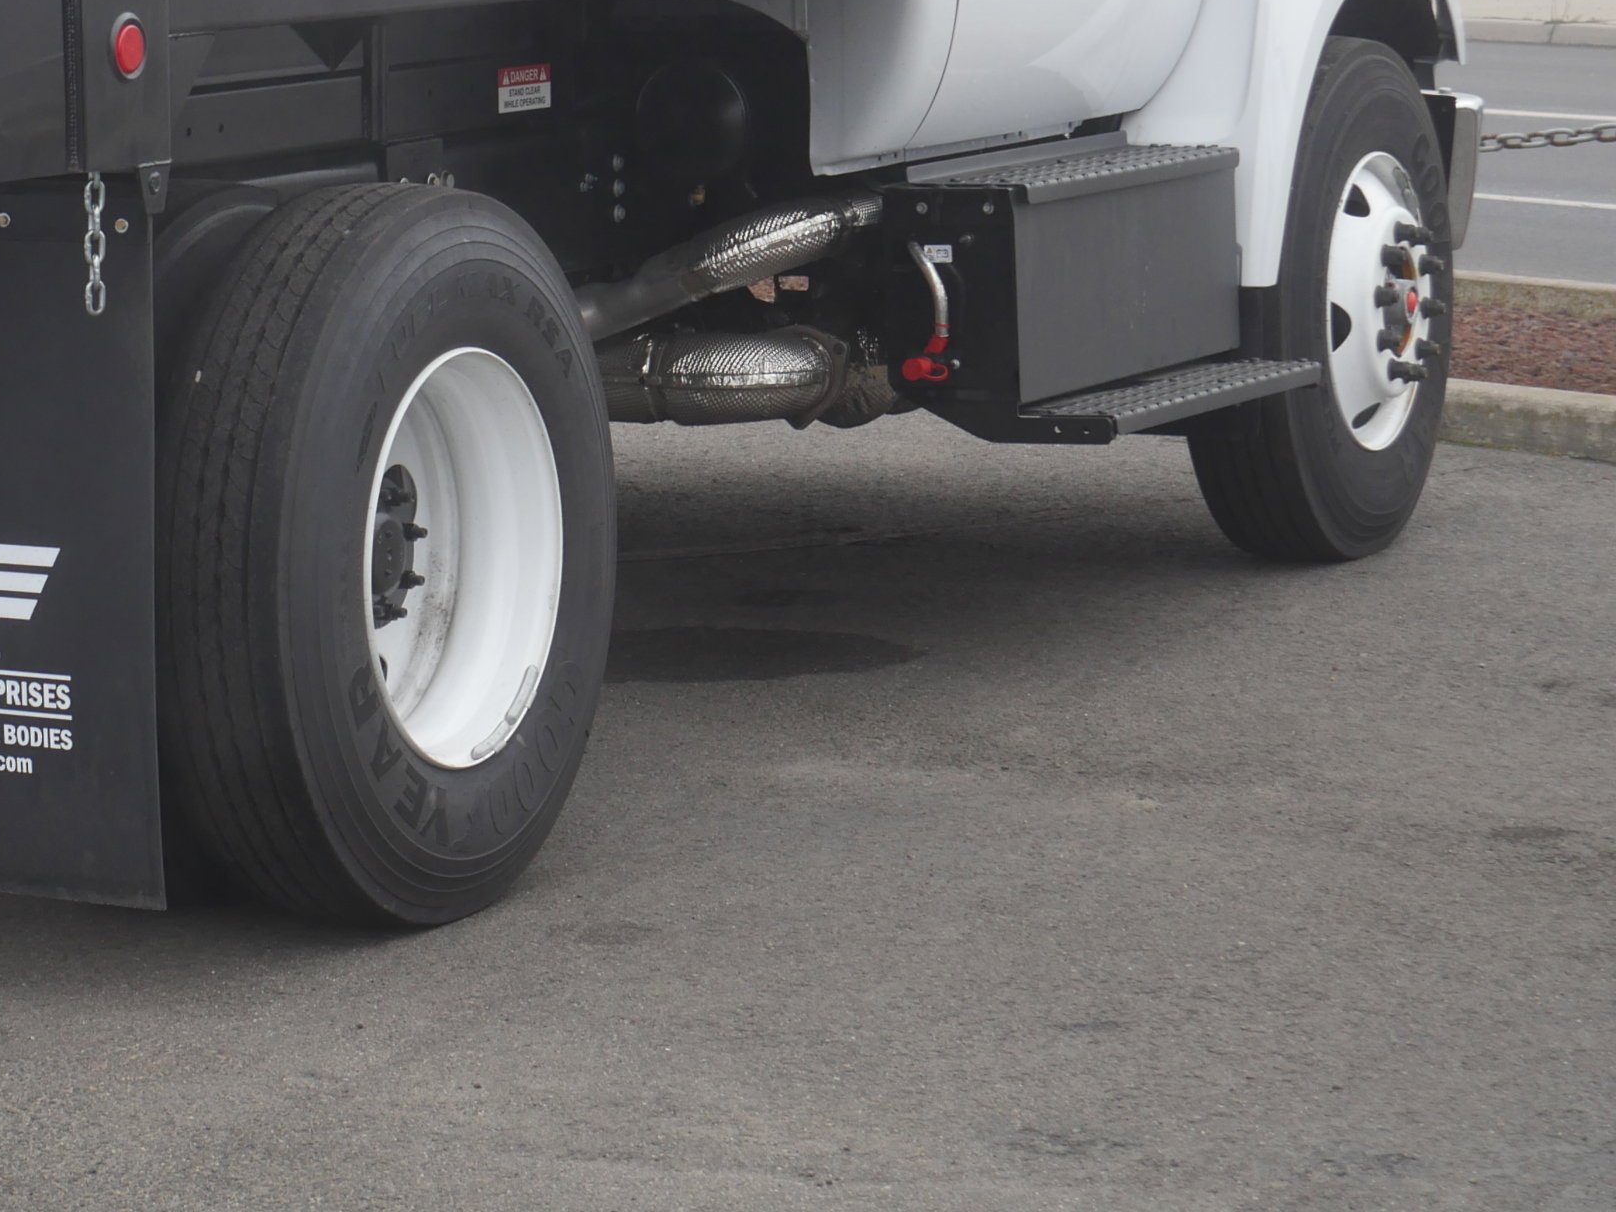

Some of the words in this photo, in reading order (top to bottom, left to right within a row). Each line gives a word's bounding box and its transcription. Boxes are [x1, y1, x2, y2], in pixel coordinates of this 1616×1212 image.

[510, 68, 539, 83] DANGER
[525, 85, 541, 96] CLEAR
[519, 96, 546, 107] OPERATING
[3, 721, 73, 751] BODIES
